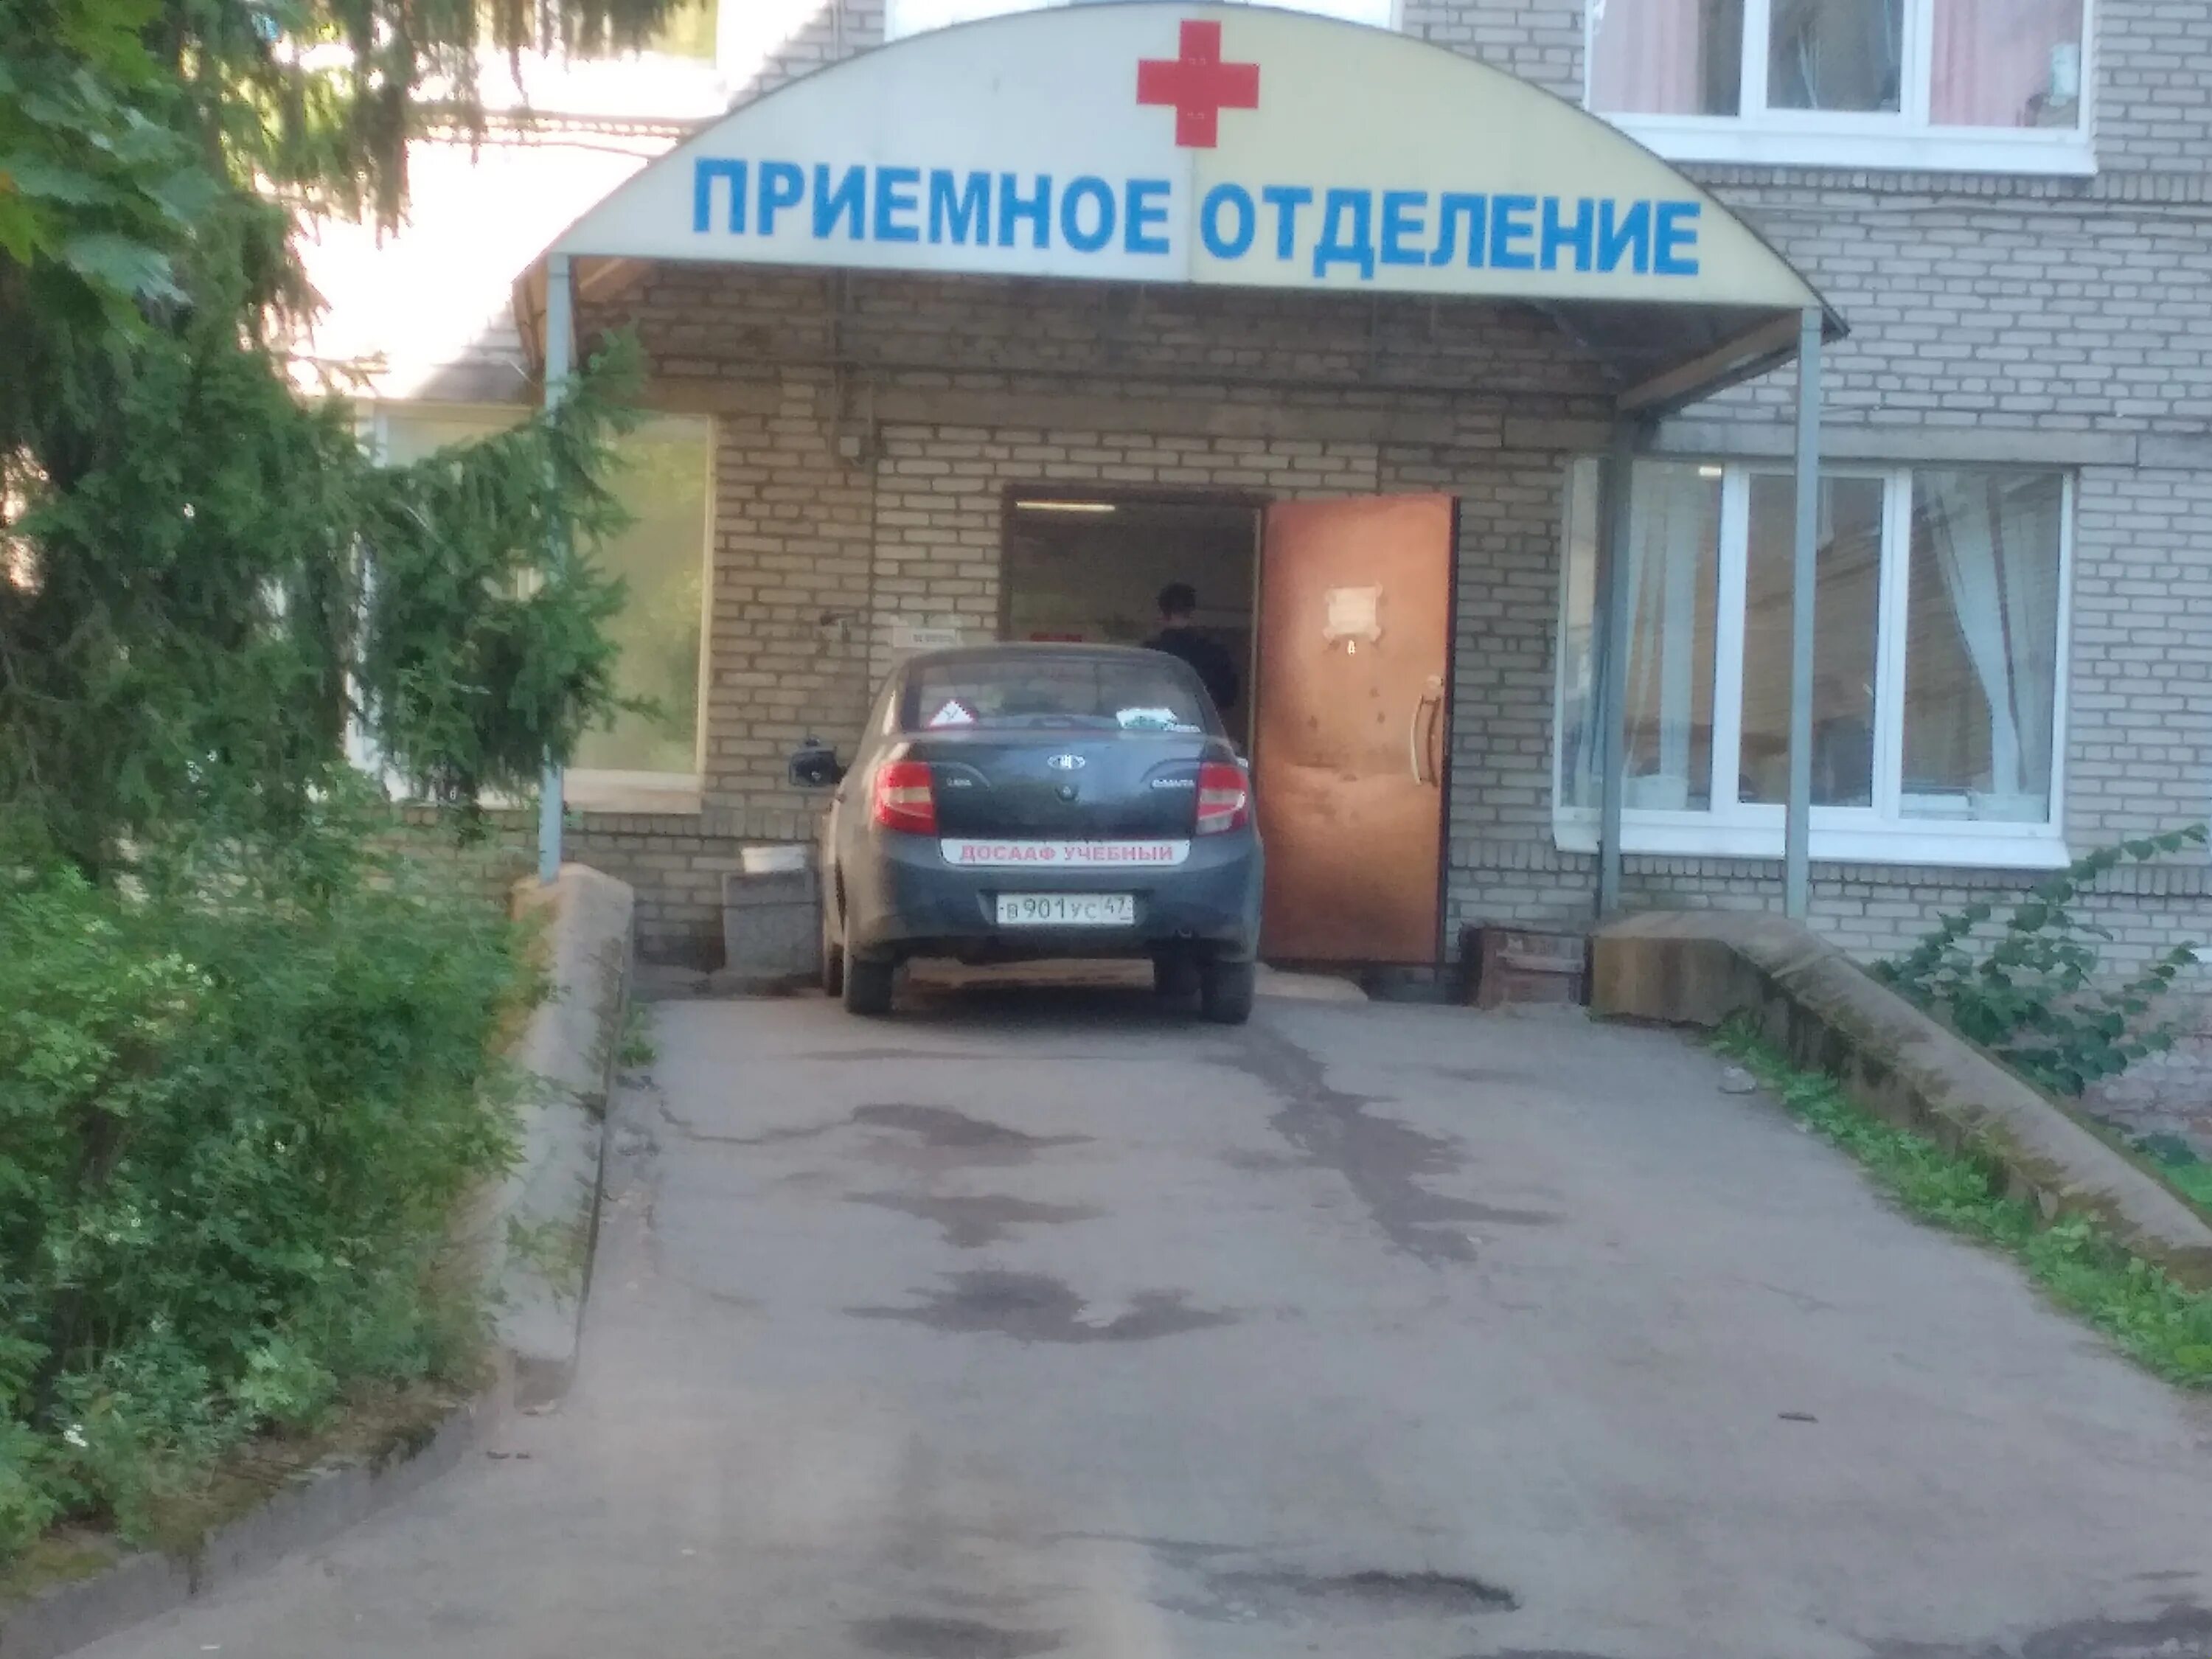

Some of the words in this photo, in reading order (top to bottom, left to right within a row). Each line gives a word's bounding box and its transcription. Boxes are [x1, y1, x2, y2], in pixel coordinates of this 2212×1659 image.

[693, 157, 1171, 255] ПРИЕМНОЕ
[1200, 183, 1701, 280] ОТДЕЛЕНИЕ
[961, 844, 1056, 863] ДОСААФ
[1064, 844, 1173, 861] УЧЕБНЫЙ
